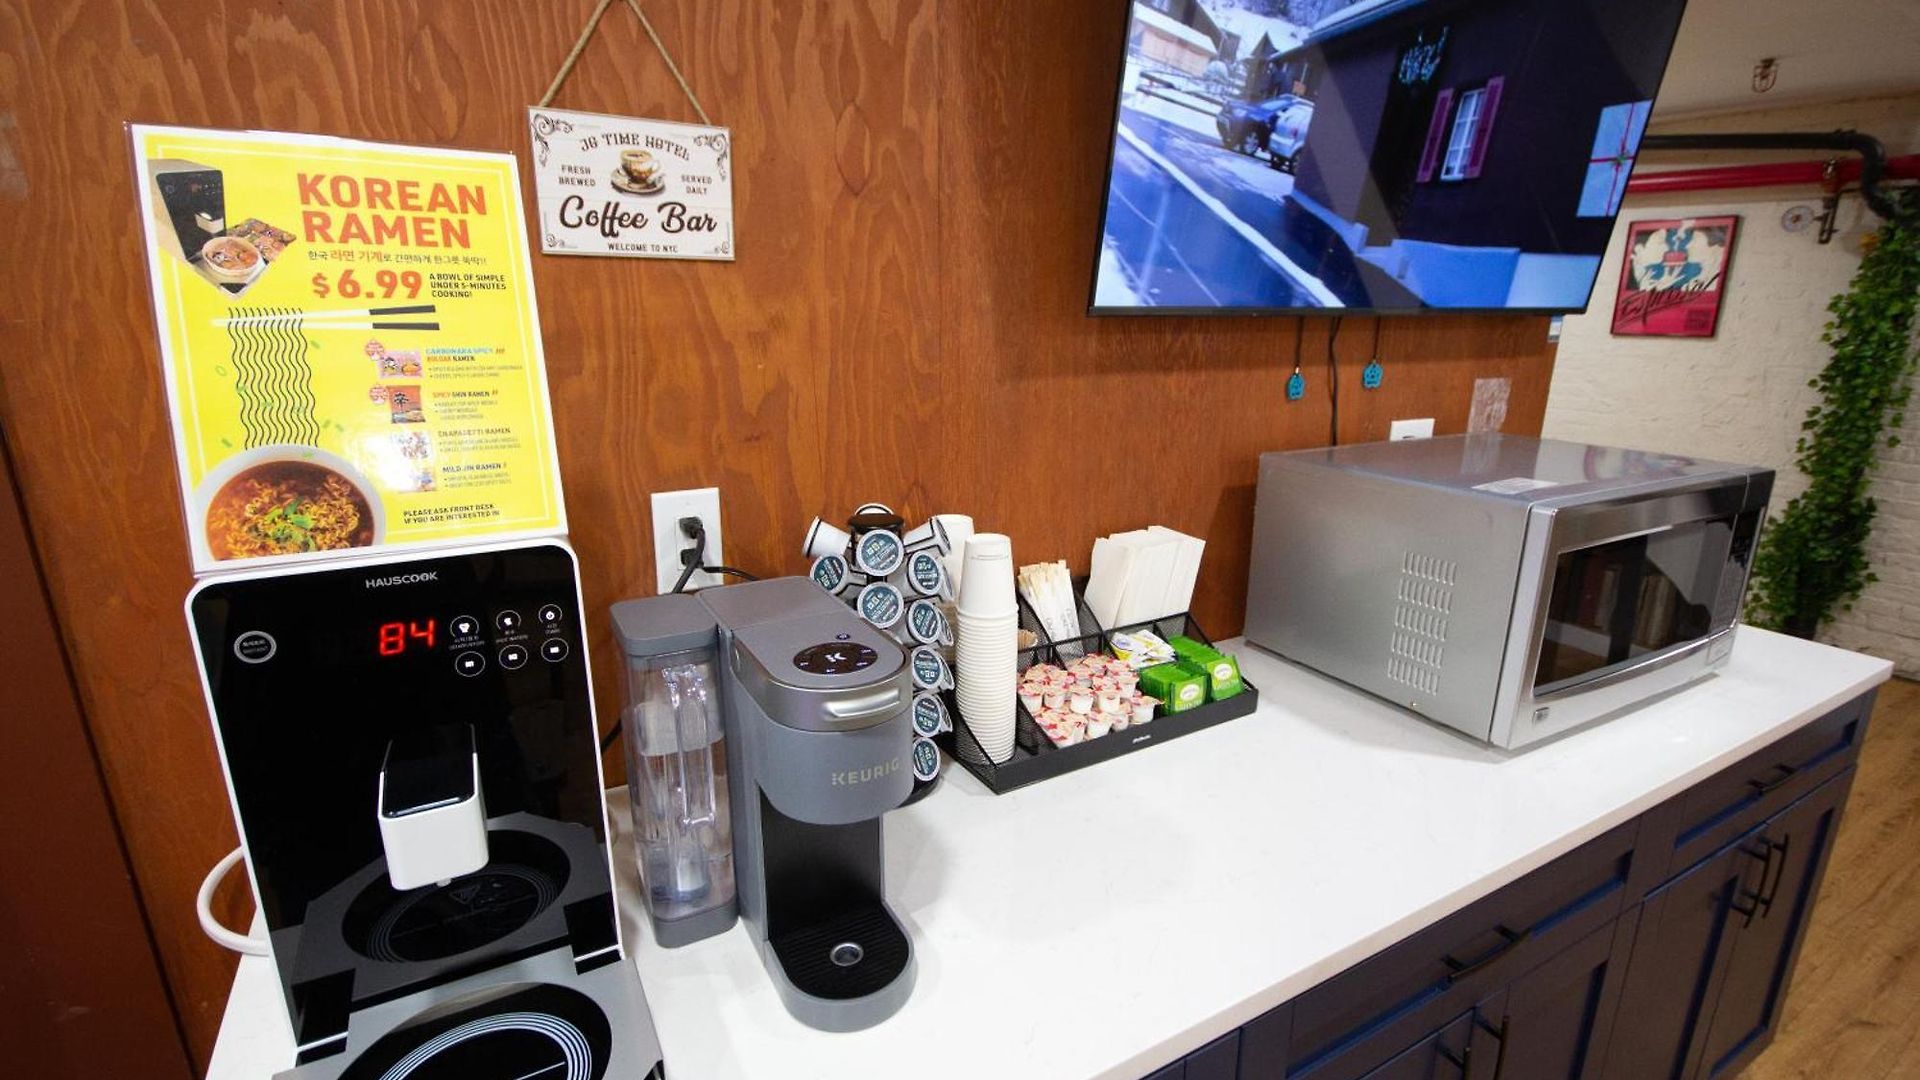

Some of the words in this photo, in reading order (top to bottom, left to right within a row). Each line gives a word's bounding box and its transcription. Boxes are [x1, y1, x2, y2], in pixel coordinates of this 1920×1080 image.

[579, 138, 598, 152] JG
[601, 133, 640, 146] TIME
[645, 136, 690, 161] HOTEL
[561, 164, 592, 175] FRESH
[558, 176, 596, 187] BREWED
[681, 174, 713, 185] SERVED
[297, 173, 487, 215] KOREAN
[685, 186, 708, 195] DAILY
[559, 195, 648, 238] Coffee
[657, 201, 718, 233] Bar
[302, 210, 471, 249] RAMEN
[608, 242, 648, 252] WELCOME
[651, 244, 661, 253] TO
[662, 244, 678, 254] NYC
[308, 250, 329, 261] 한국
[330, 249, 355, 262] 라면
[437, 273, 461, 281] BOWL
[463, 273, 473, 281] OF
[475, 274, 505, 282] SIMPLE
[312, 269, 422, 299] $6.99
[430, 281, 460, 289] UNDER
[431, 290, 473, 298] COOKING!
[442, 465, 461, 473] MILD
[403, 508, 432, 517] PLEASE
[450, 504, 474, 513] FRONT
[446, 511, 491, 521] INTERESTED
[365, 571, 438, 589] HAUSCOOK
[379, 619, 435, 656] 84
[831, 757, 900, 786] KEURIG
